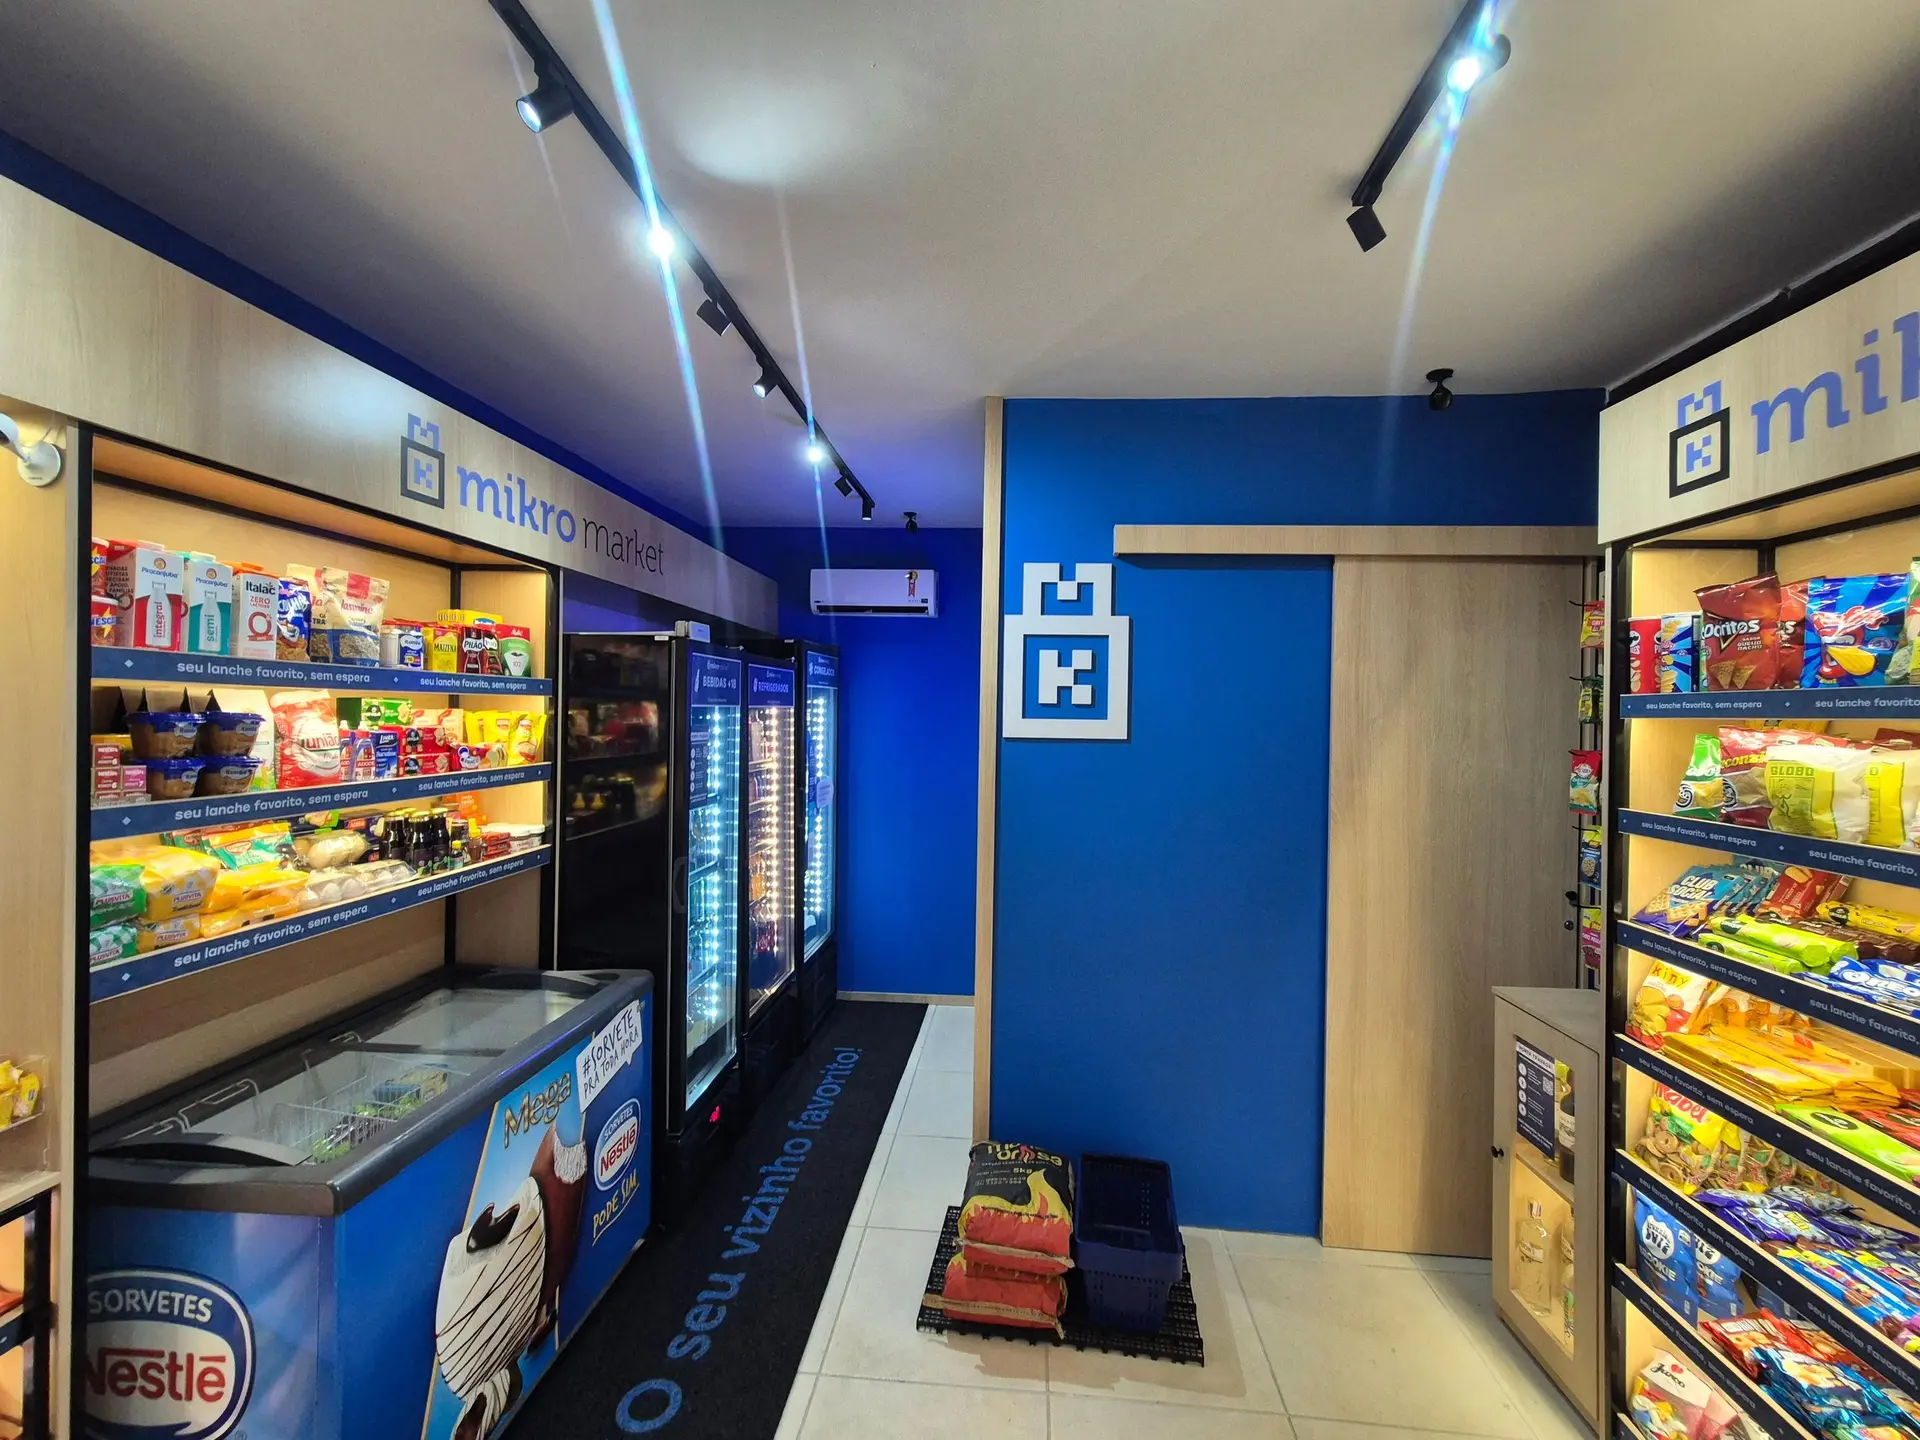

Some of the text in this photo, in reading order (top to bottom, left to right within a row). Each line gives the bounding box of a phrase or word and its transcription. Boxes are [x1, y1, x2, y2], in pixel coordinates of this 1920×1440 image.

[457, 466, 664, 576] mikro market
[246, 580, 276, 595] Italac
[250, 596, 271, 605] ZERO
[153, 600, 164, 639] integral
[204, 613, 216, 643] semi
[1704, 619, 1760, 639] Doritos
[177, 662, 370, 684] seu lanche favorito, sem espera
[420, 677, 434, 686] seu
[436, 677, 460, 687] lanche
[506, 682, 526, 692] espera
[703, 675, 726, 689] BEBIDAS
[1646, 702, 1657, 710] seu
[1658, 701, 1681, 709] lanche
[1682, 701, 1713, 710] favorito,
[1733, 701, 1762, 710] espera
[1815, 699, 1833, 708] seu
[1835, 697, 1871, 708] lanche
[434, 779, 459, 789] lanche
[490, 775, 503, 783] sem
[504, 772, 524, 781] espera
[1770, 765, 1815, 777] GLOBO
[175, 789, 369, 821] seu lanche favorito, sem espera
[1642, 821, 1757, 848] seu lanche favorito, sem espera
[417, 887, 433, 897] seu
[434, 879, 458, 893] lanche
[488, 866, 503, 876] sem
[504, 859, 524, 872] espera
[1809, 848, 1918, 877] seu lanche favorito,
[1668, 884, 1713, 900] SOCIAL
[1680, 875, 1719, 891] CLUB
[174, 904, 368, 968] seu lanche favorito, sem espera
[1642, 938, 1758, 986] seu lanche favorito, sem espera
[1809, 998, 1828, 1011] seu
[1830, 1002, 1866, 1026] lanche
[582, 1007, 634, 1078] #SORVETE
[583, 1029, 639, 1101] PRA TODA HORA
[1638, 1056, 1650, 1069] seu
[1651, 1062, 1674, 1083] lanche
[1706, 1094, 1724, 1108] sem
[1724, 1103, 1754, 1125] espera
[504, 1072, 571, 1150] Mega
[603, 1104, 634, 1140] SORVETES
[600, 1122, 637, 1177] Nestlé
[1805, 1148, 1824, 1163] seu
[1825, 1156, 1863, 1183] lanche
[592, 1168, 638, 1239] PODE SIM
[1639, 1177, 1650, 1189] seu
[1651, 1182, 1674, 1206] lanche
[1706, 1228, 1725, 1245] sem
[1725, 1241, 1756, 1268] espera
[615, 1046, 863, 1434] O seu vizinho favorito!
[88, 1288, 213, 1324] SORVETES
[1807, 1300, 1827, 1320] seu
[1828, 1309, 1865, 1350] lanche
